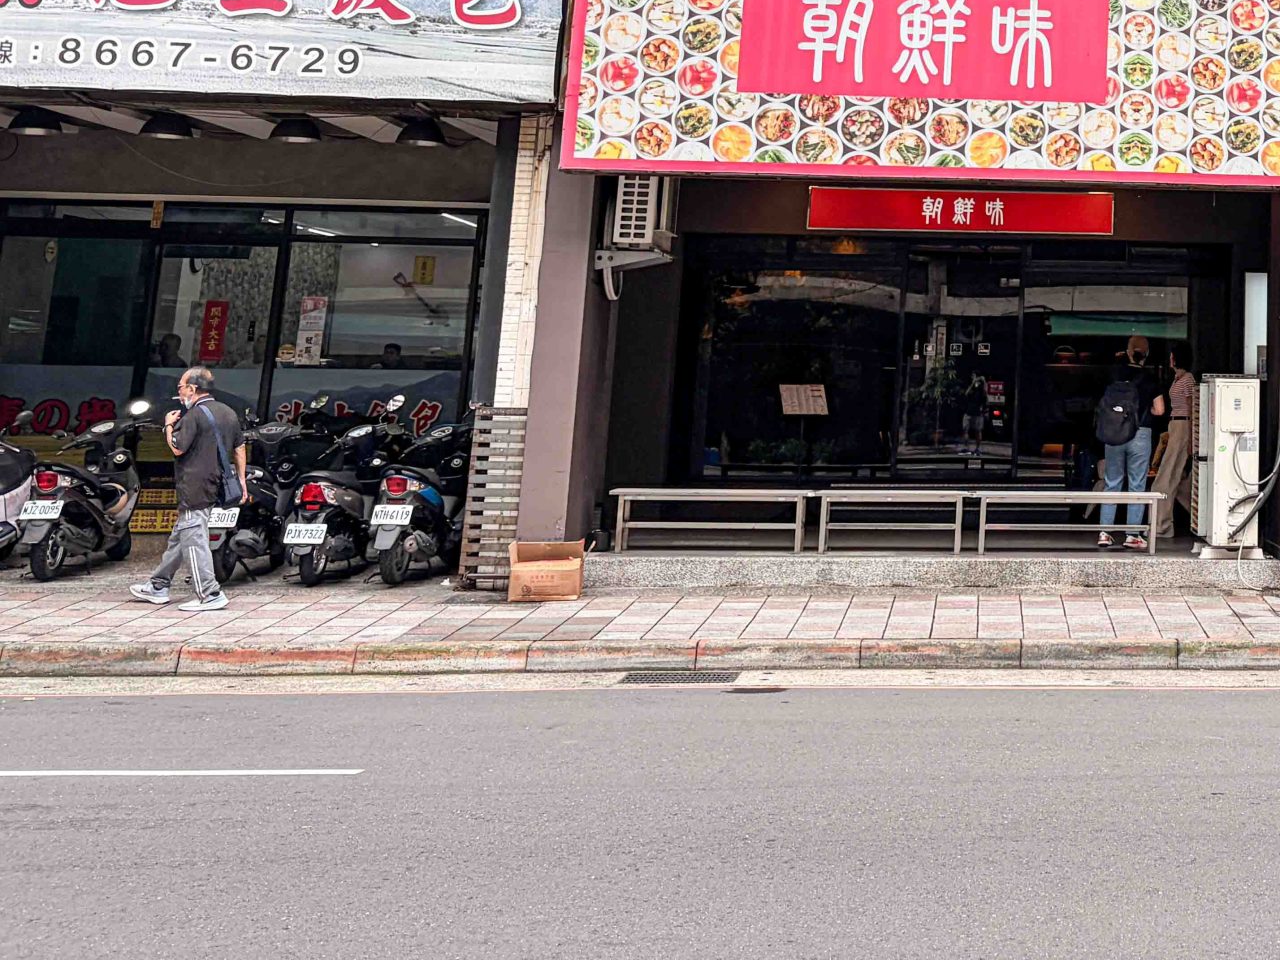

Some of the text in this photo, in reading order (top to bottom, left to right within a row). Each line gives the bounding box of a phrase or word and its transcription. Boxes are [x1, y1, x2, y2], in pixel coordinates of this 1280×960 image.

[921, 196, 1005, 226] 朝鮮味
[207, 512, 237, 523] E-3018
[373, 508, 411, 521] NTH-6119
